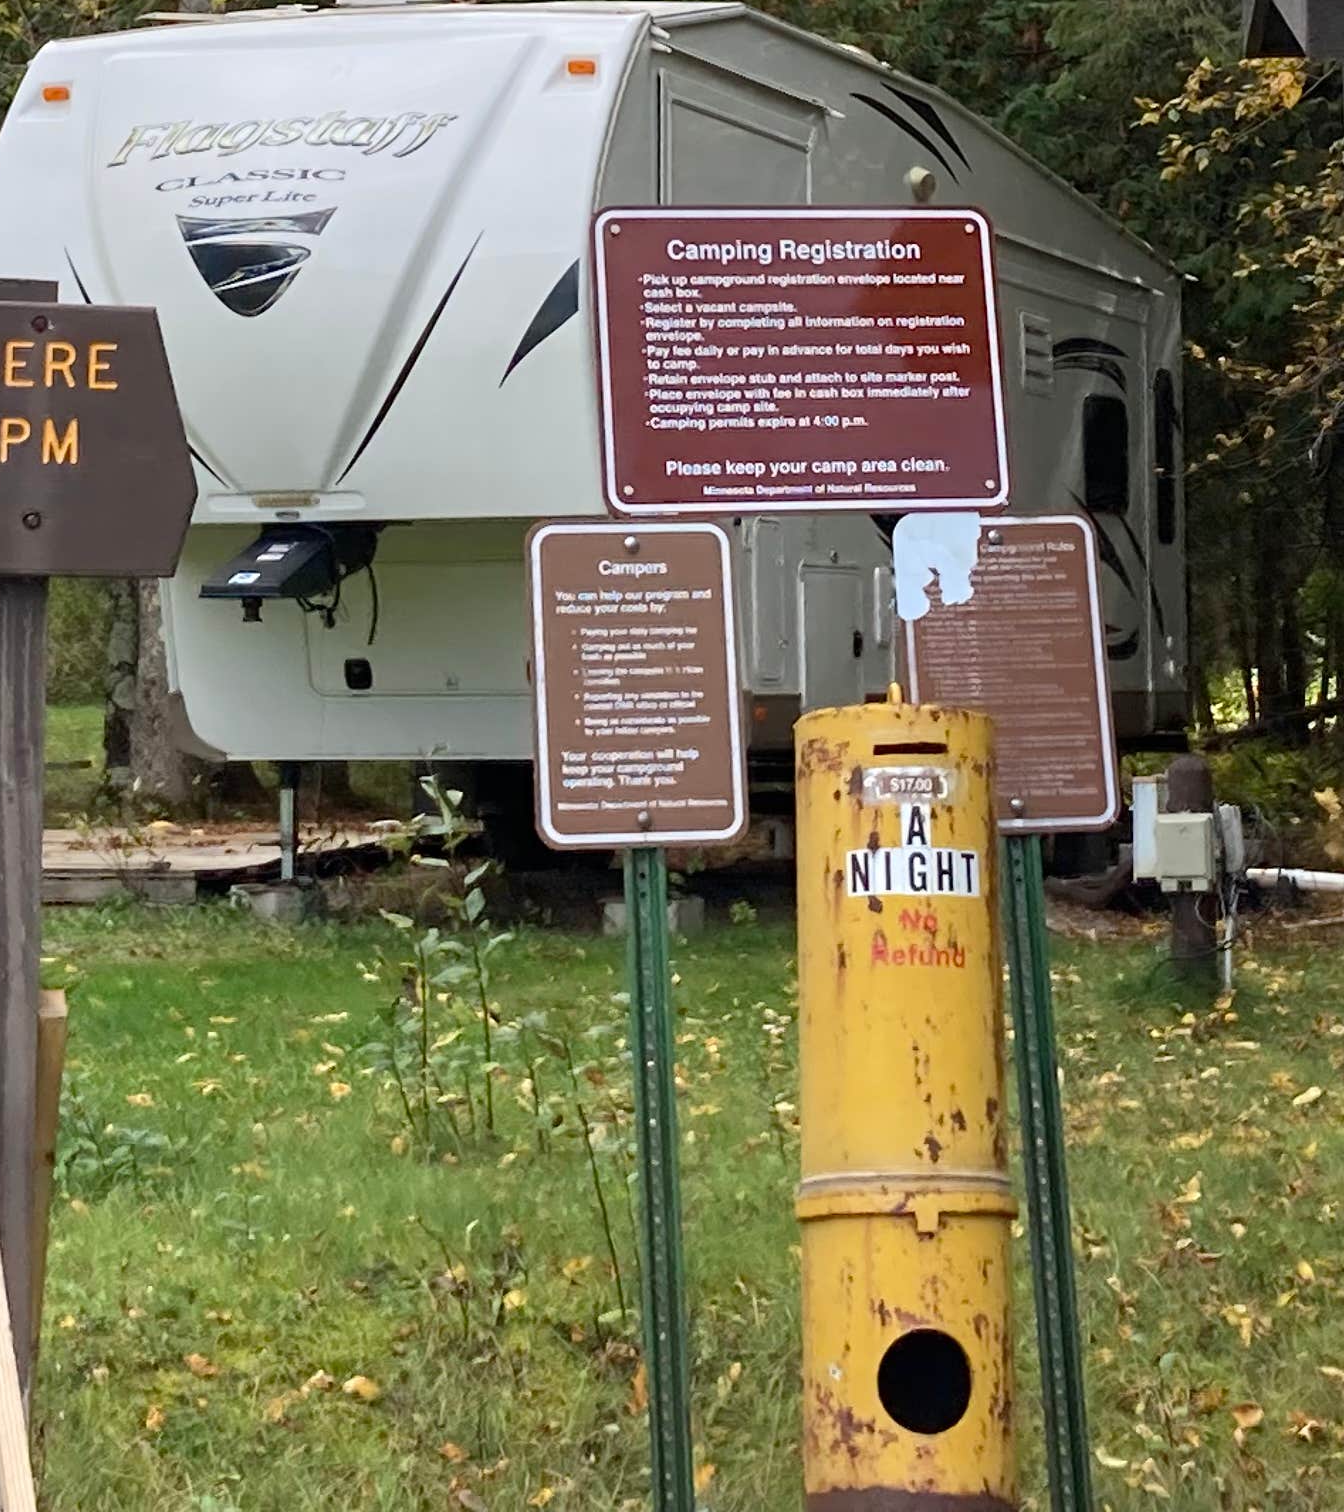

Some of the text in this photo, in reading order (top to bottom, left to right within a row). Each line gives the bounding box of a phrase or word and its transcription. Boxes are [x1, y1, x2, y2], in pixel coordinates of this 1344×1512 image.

[107, 110, 458, 167] Flagstaff
[155, 168, 346, 191] CLASSIC
[189, 190, 317, 209] Super Lite
[667, 239, 921, 265] Camping Registration
[643, 273, 964, 287] Pick up campground registration envelope located near
[643, 288, 672, 298] cash
[644, 302, 682, 312] Select
[686, 304, 693, 312] a
[696, 302, 736, 312] vacant
[646, 316, 964, 330] Register by completing all information on registration
[647, 343, 970, 358] Pay fee daily or pay in advance for total days you wish
[648, 359, 659, 369] to
[649, 374, 687, 384] Retain
[690, 374, 746, 385] envelope
[749, 373, 776, 383] stub
[779, 373, 801, 383] and
[805, 373, 842, 382] attach
[845, 372, 857, 382] to
[861, 372, 882, 382] site
[886, 372, 927, 382] marker
[649, 386, 970, 401] Place envelope with fee in cash box immediately after
[650, 401, 714, 415] occupying
[717, 403, 750, 414] camp
[650, 417, 705, 431] Camping
[709, 417, 754, 430] permits
[758, 417, 795, 429] expire
[799, 417, 810, 426] at
[666, 457, 950, 477] Please keep your camp area clean.
[598, 560, 667, 578] Campers
[619, 775, 651, 785] Thank
[890, 776, 933, 793] $17.00
[906, 805, 927, 845] A
[851, 853, 976, 892] NIGHT
[900, 908, 937, 933] No
[872, 932, 965, 969] Refund
